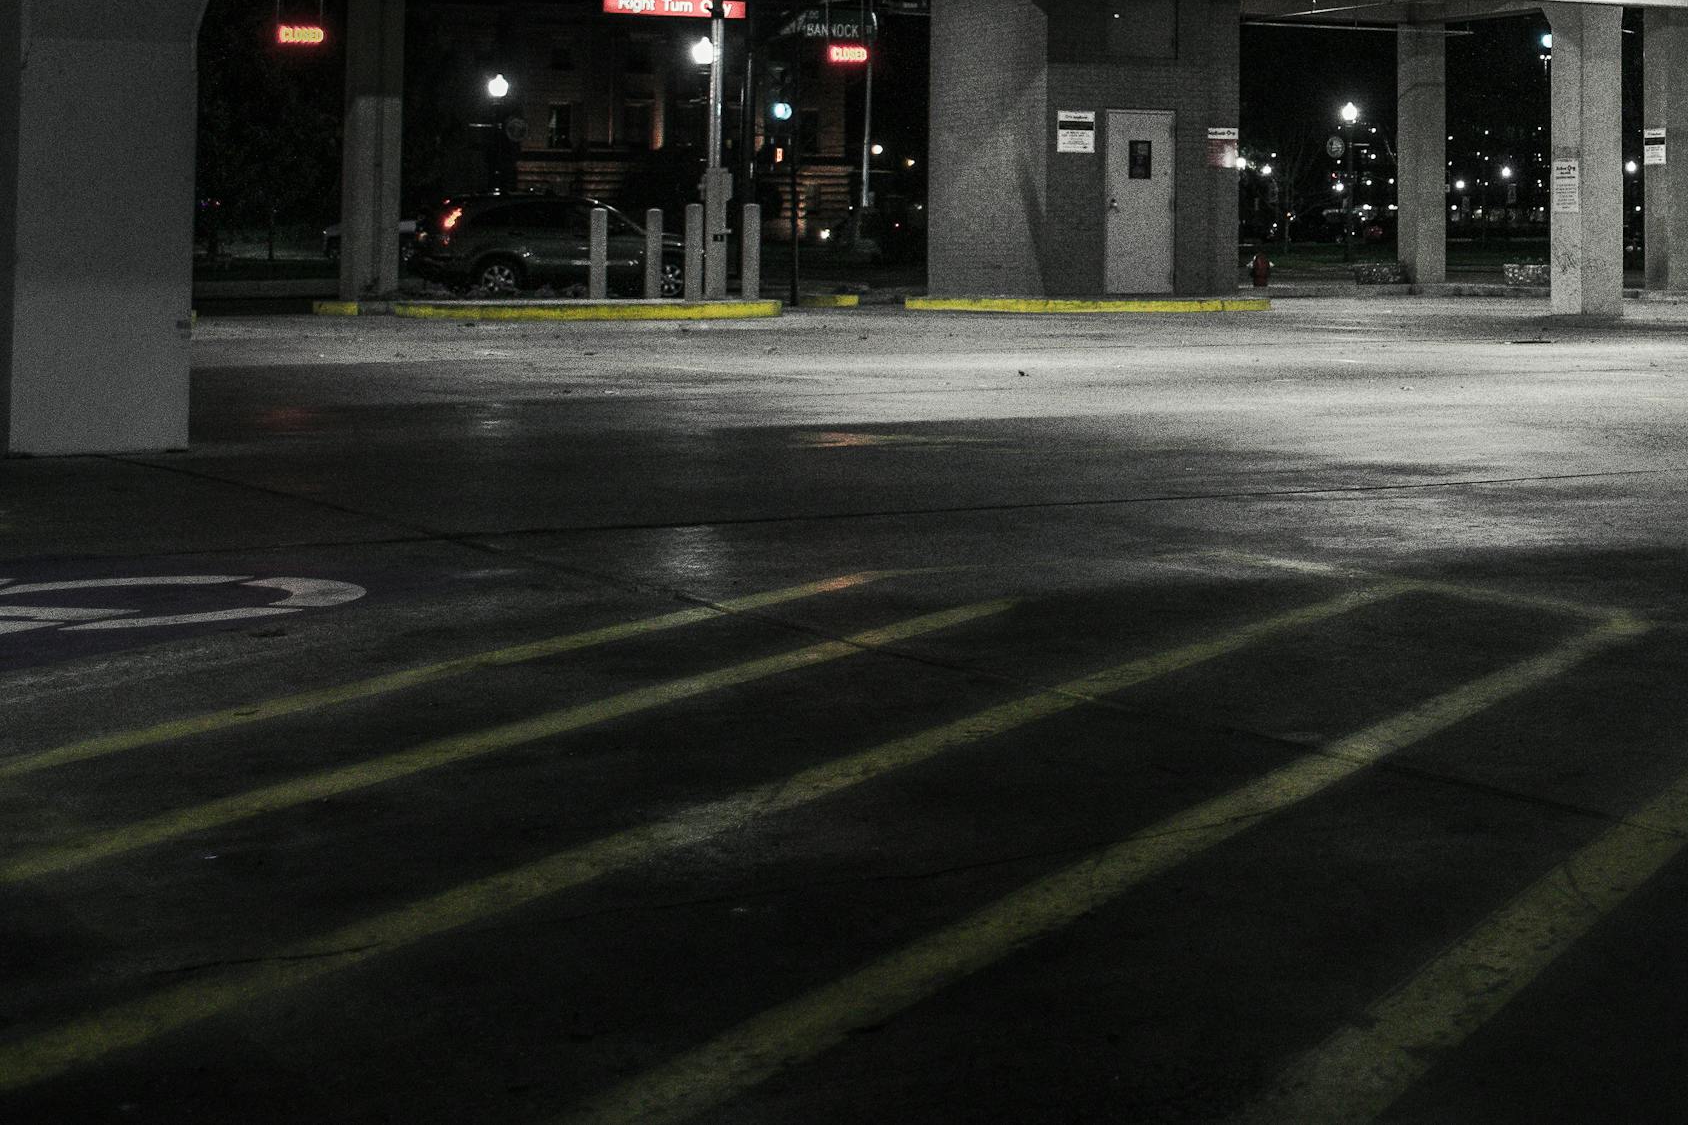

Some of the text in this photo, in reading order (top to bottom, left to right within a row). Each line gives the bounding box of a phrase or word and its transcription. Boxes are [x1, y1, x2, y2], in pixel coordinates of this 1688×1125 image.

[700, 0, 733, 17] Oy
[279, 26, 324, 44] CLOSED
[806, 23, 860, 38] BANNOCK
[829, 45, 868, 62] CLOSED
